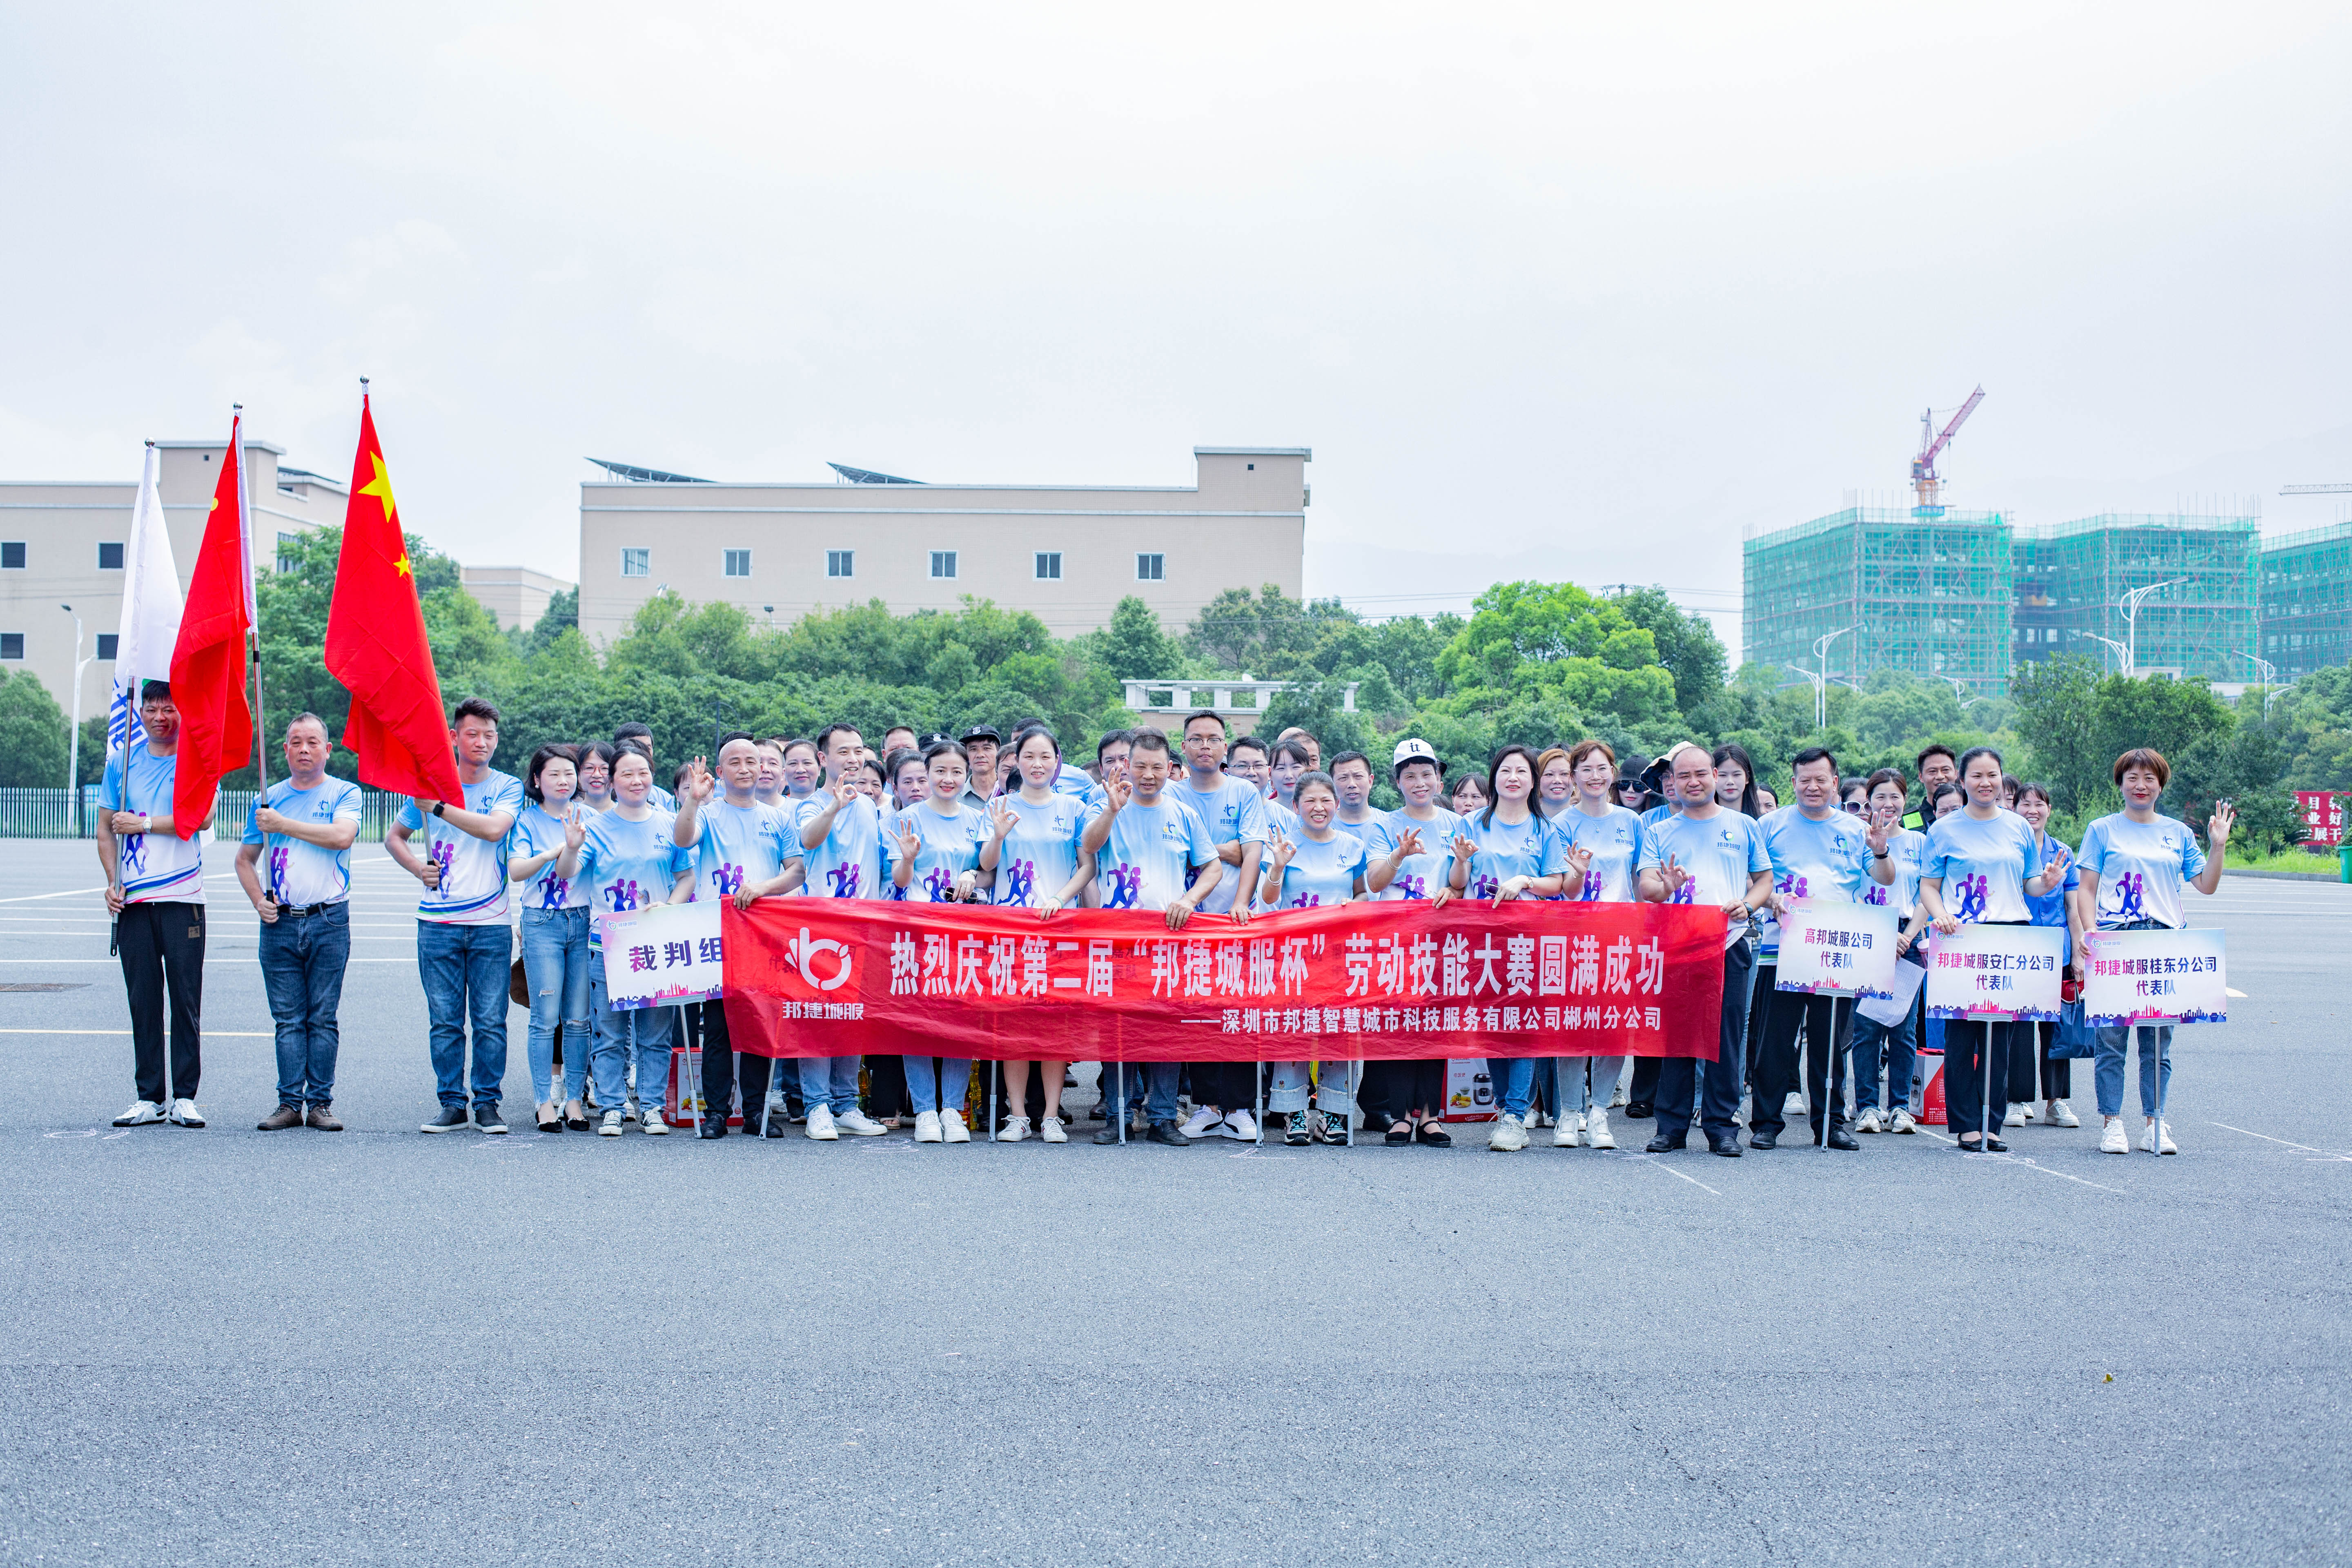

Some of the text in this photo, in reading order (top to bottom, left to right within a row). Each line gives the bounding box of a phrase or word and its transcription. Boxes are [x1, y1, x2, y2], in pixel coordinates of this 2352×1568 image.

[1805, 928, 1872, 949] 高邦城服公司
[629, 937, 722, 973] 裁判组
[1821, 951, 1853, 969] 代表队
[1938, 952, 2054, 971] 邦捷城服安仁分公司
[2094, 956, 2216, 976] 邦捷城服桂东分公司
[1976, 975, 2013, 991] 代表队
[2136, 980, 2176, 996] 代表队
[782, 1002, 864, 1020] 邦捷城服
